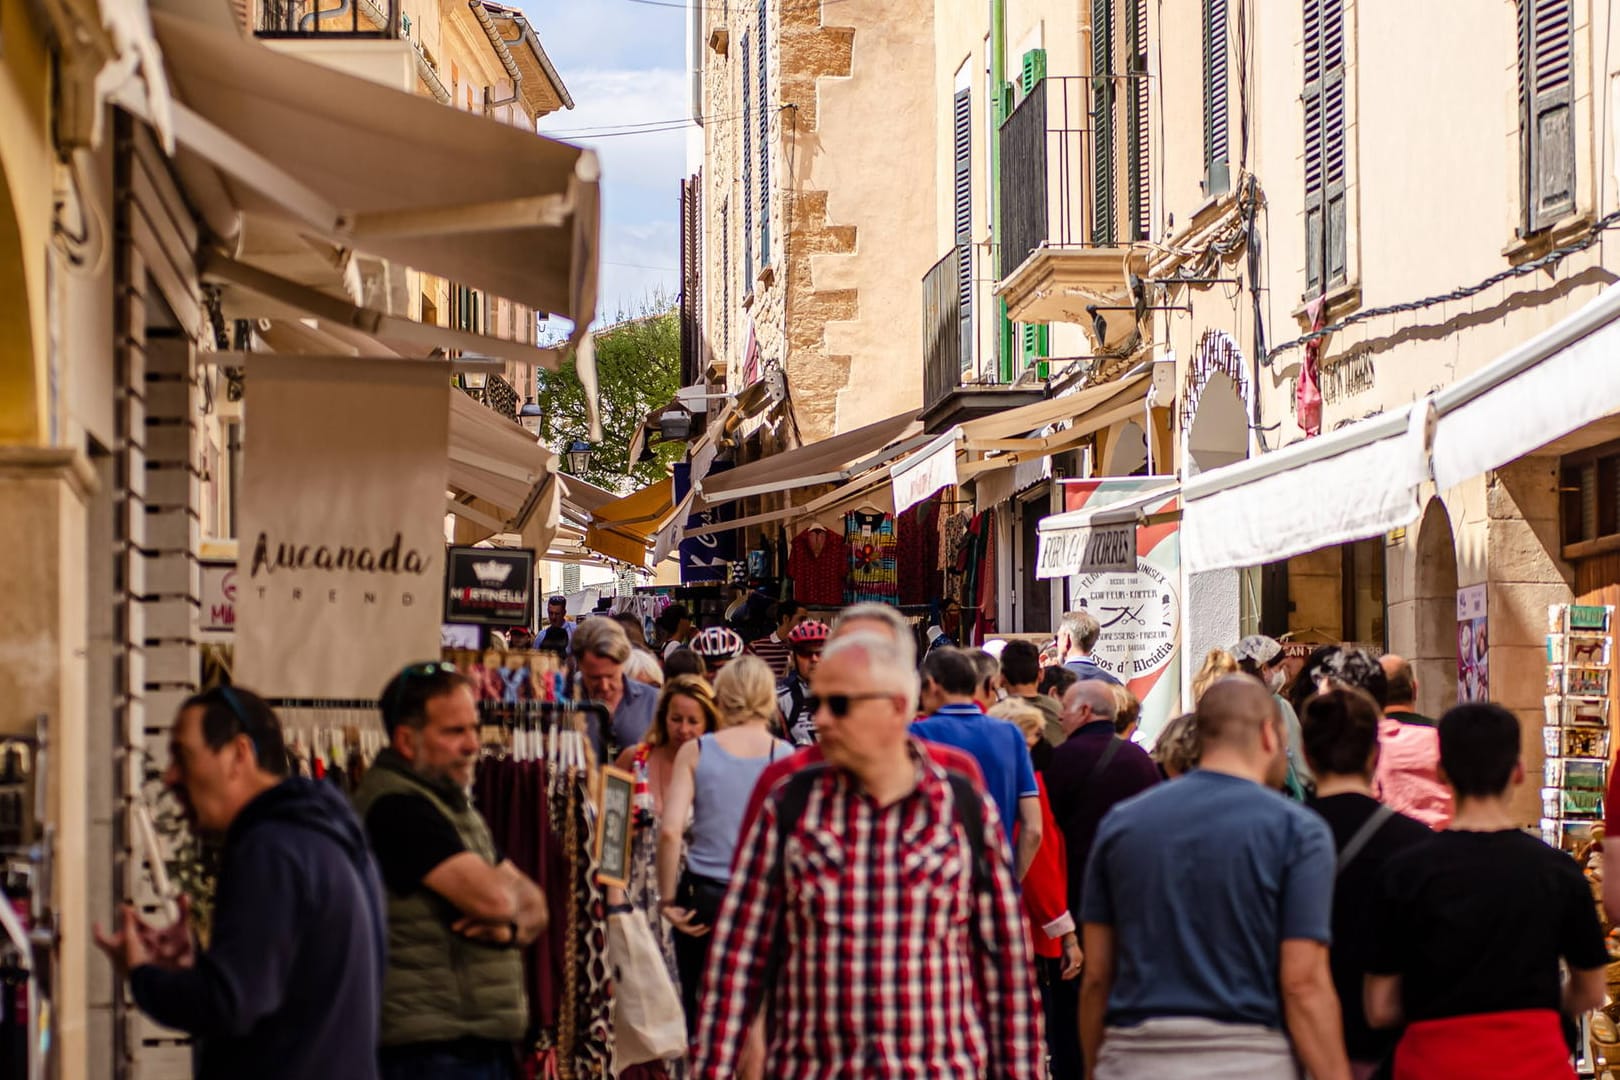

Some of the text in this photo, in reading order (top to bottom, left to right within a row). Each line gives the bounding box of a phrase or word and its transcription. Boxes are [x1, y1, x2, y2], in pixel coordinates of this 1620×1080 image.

[250, 532, 431, 578] Aucanada
[1090, 530, 1129, 566] TORRES
[257, 587, 413, 606] TREND
[1133, 641, 1174, 673] Alcúdia
